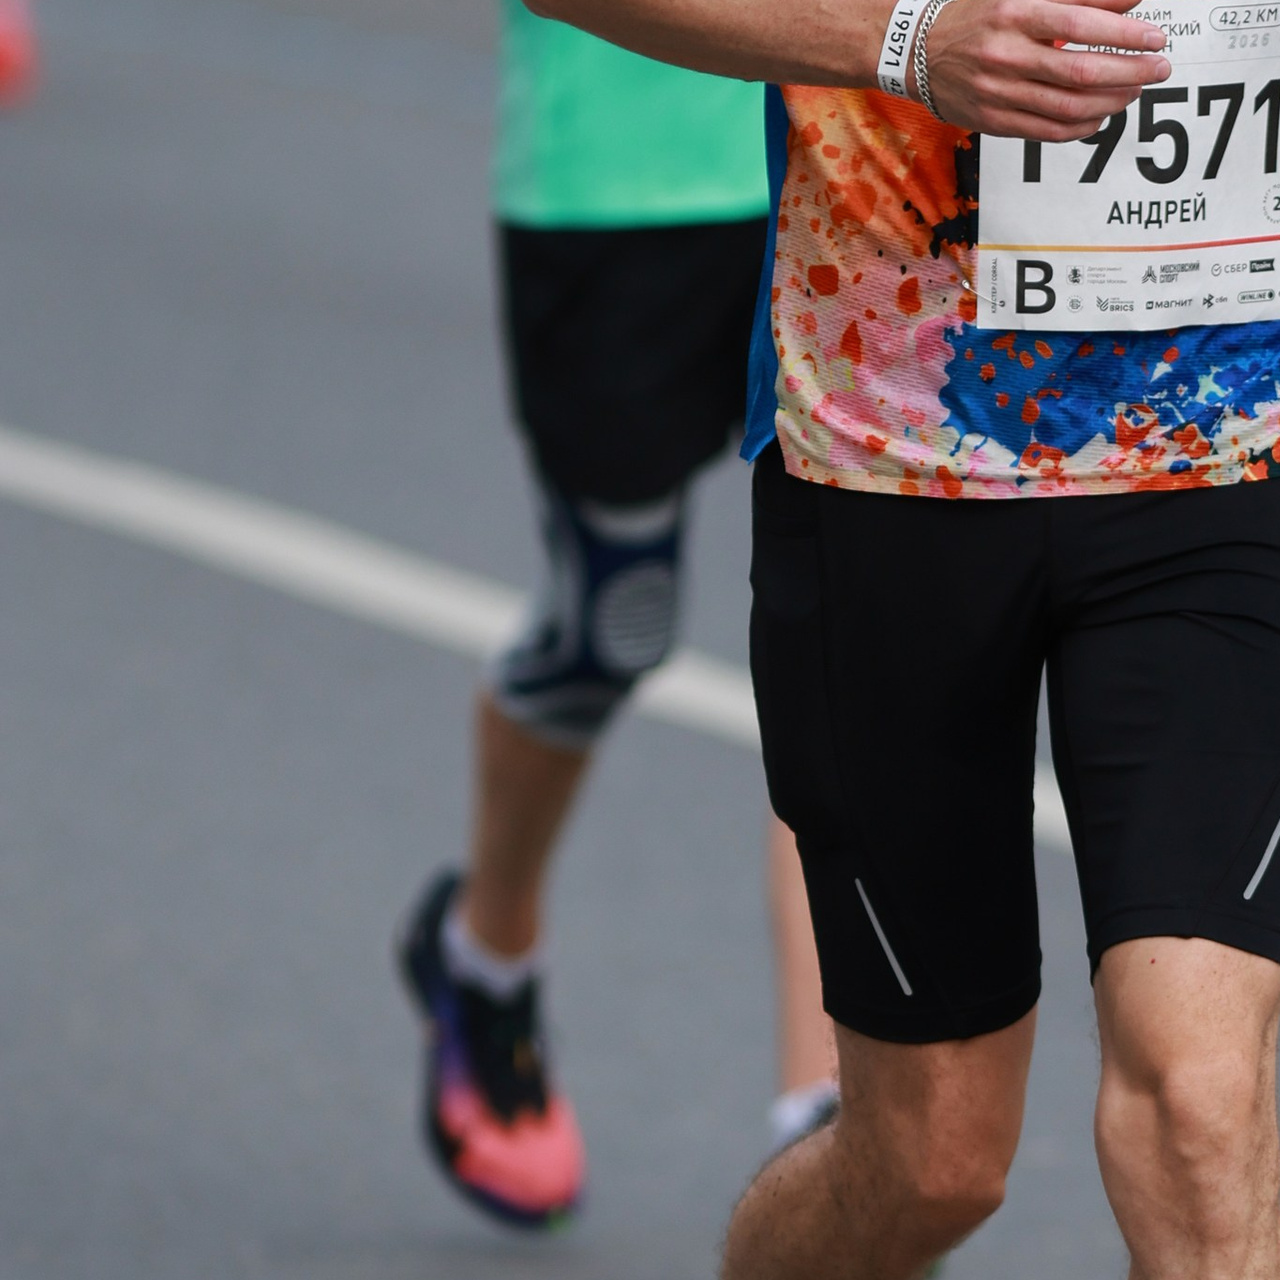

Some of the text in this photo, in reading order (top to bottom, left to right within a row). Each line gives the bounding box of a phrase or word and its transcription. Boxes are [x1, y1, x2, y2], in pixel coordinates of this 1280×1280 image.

[1218, 9, 1252, 26] 42,2
[884, 9, 914, 68] 19571
[1106, 192, 1208, 230] АНДРЕЙ
[1223, 263, 1248, 274] СБЕР
[1109, 304, 1135, 313] BRICS
